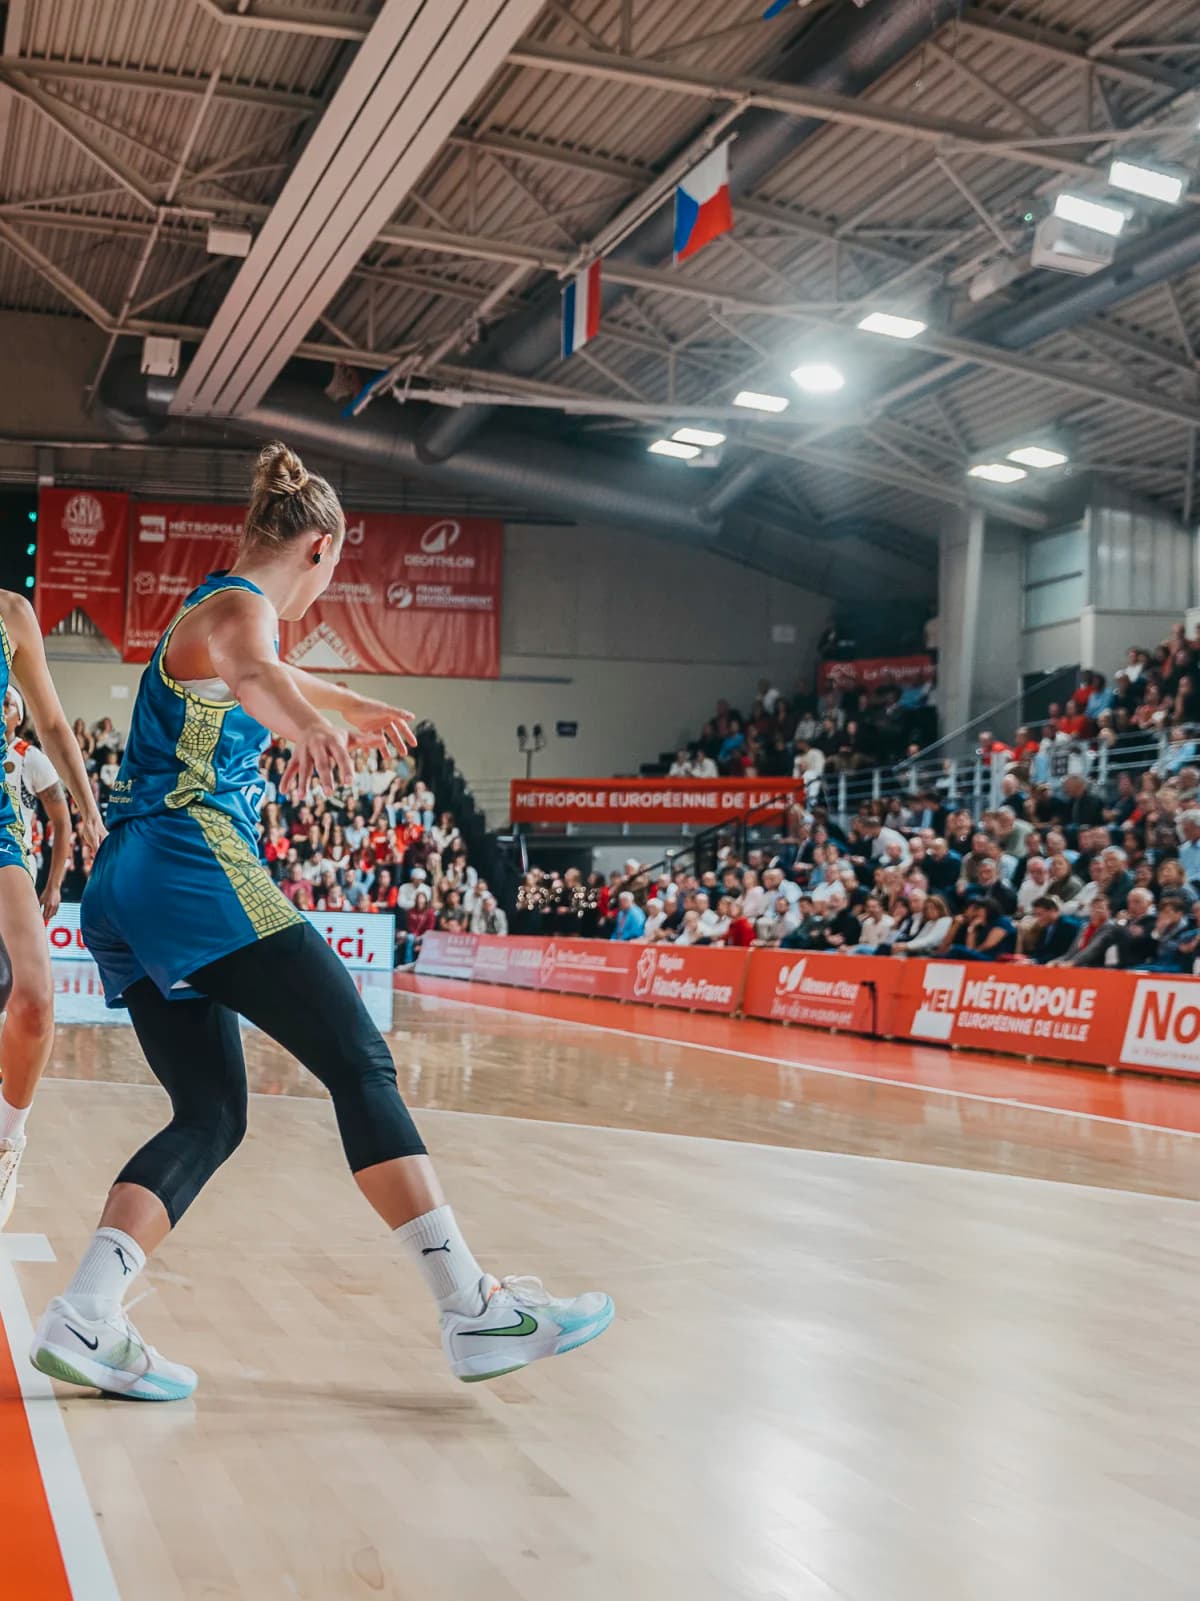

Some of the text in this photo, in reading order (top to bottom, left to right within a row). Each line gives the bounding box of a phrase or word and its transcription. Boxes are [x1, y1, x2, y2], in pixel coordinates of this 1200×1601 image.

[516, 789, 606, 808] MÉTROPOLE
[609, 789, 718, 809] EUROPÉENNE
[721, 792, 745, 809] DE
[963, 975, 1097, 1019] MÉTROPOLE
[957, 1011, 1090, 1041] EUROPÉENNE DE LILLE
